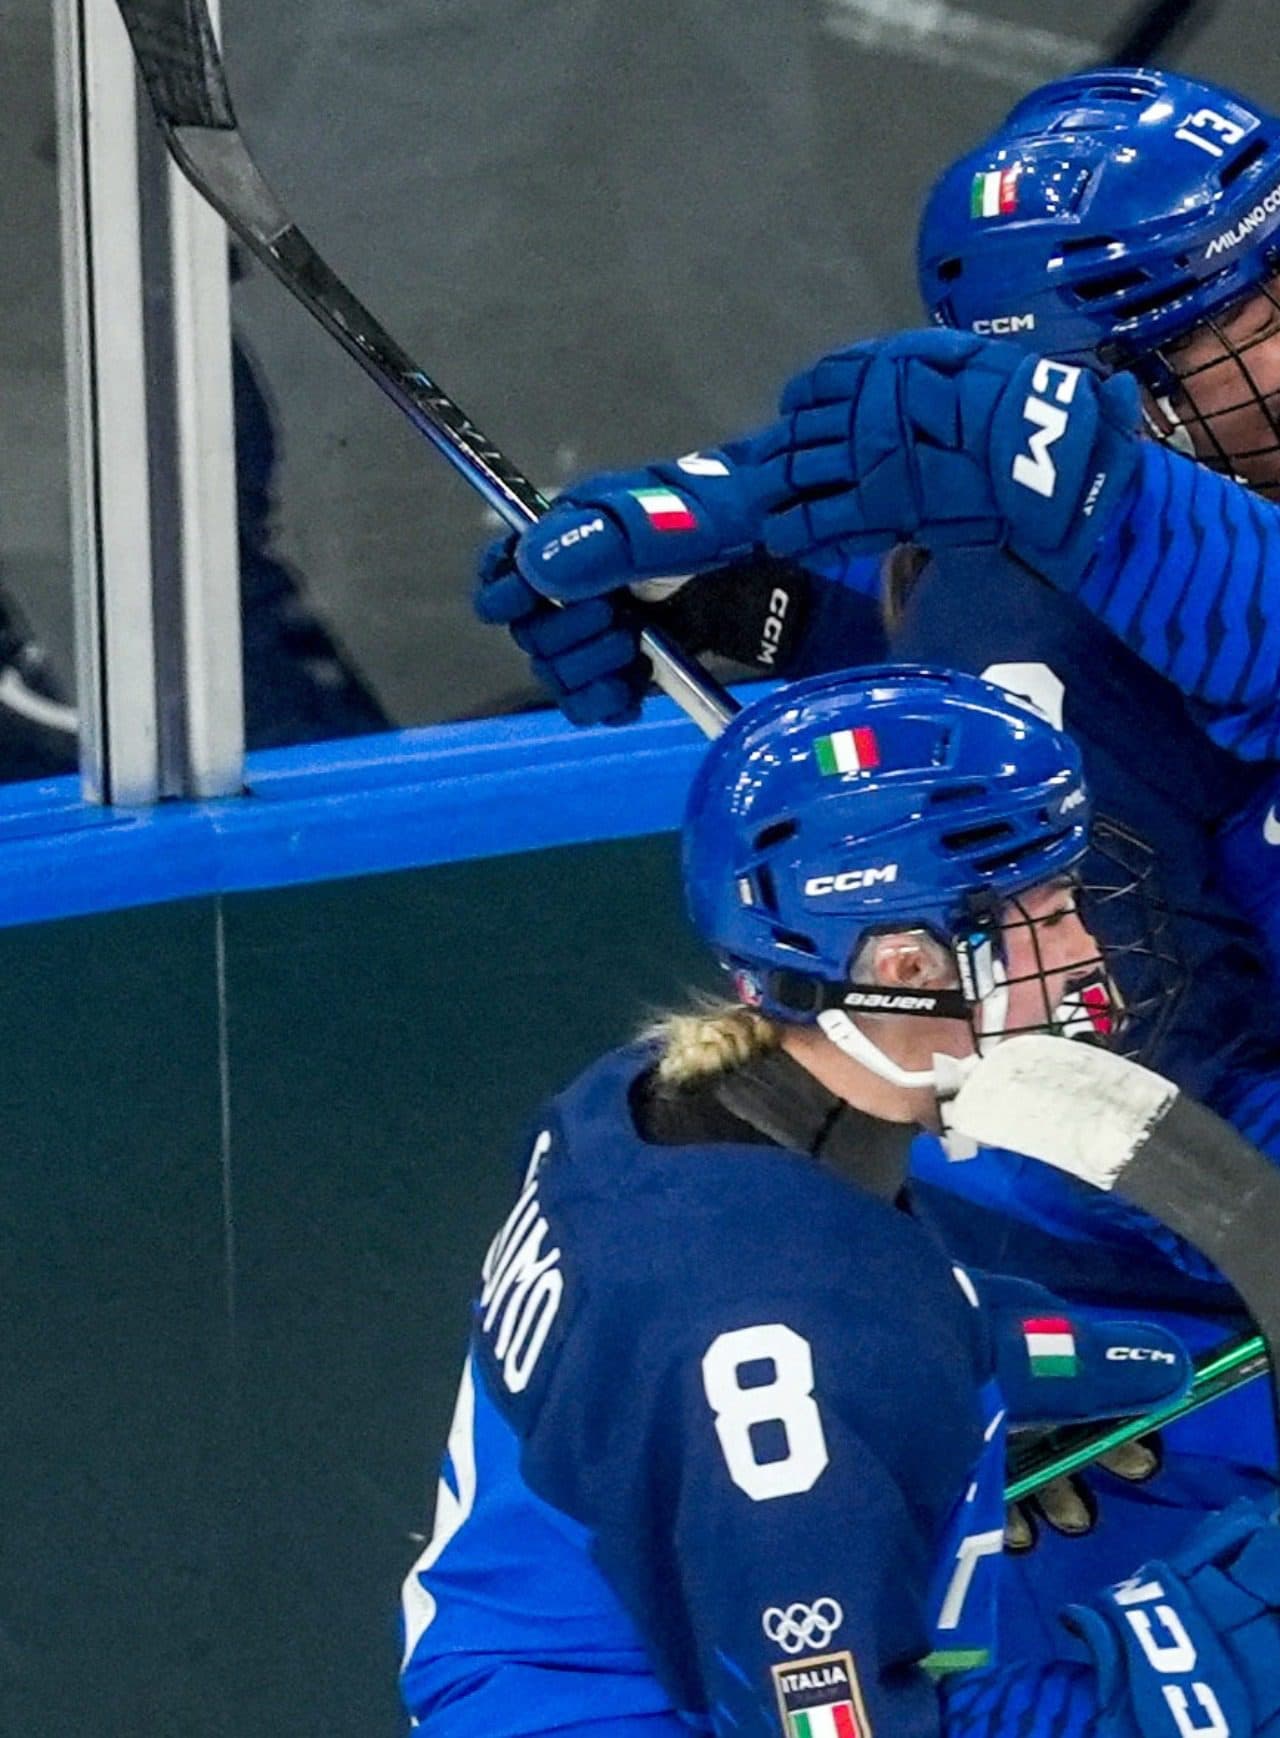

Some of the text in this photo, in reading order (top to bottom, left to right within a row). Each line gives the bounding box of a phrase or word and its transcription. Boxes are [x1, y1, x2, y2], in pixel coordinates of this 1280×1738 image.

[1174, 108, 1245, 157] 13
[1205, 206, 1266, 259] MILANO
[973, 314, 1035, 335] CCM
[1012, 358, 1083, 498] CM
[541, 518, 604, 561] CCM
[757, 588, 790, 665] CCM
[804, 863, 897, 897] CCM
[843, 991, 938, 1011] BAUER
[1106, 1346, 1176, 1365] CCM
[702, 1324, 830, 1501] 8
[781, 1666, 848, 1693] ITALIA
